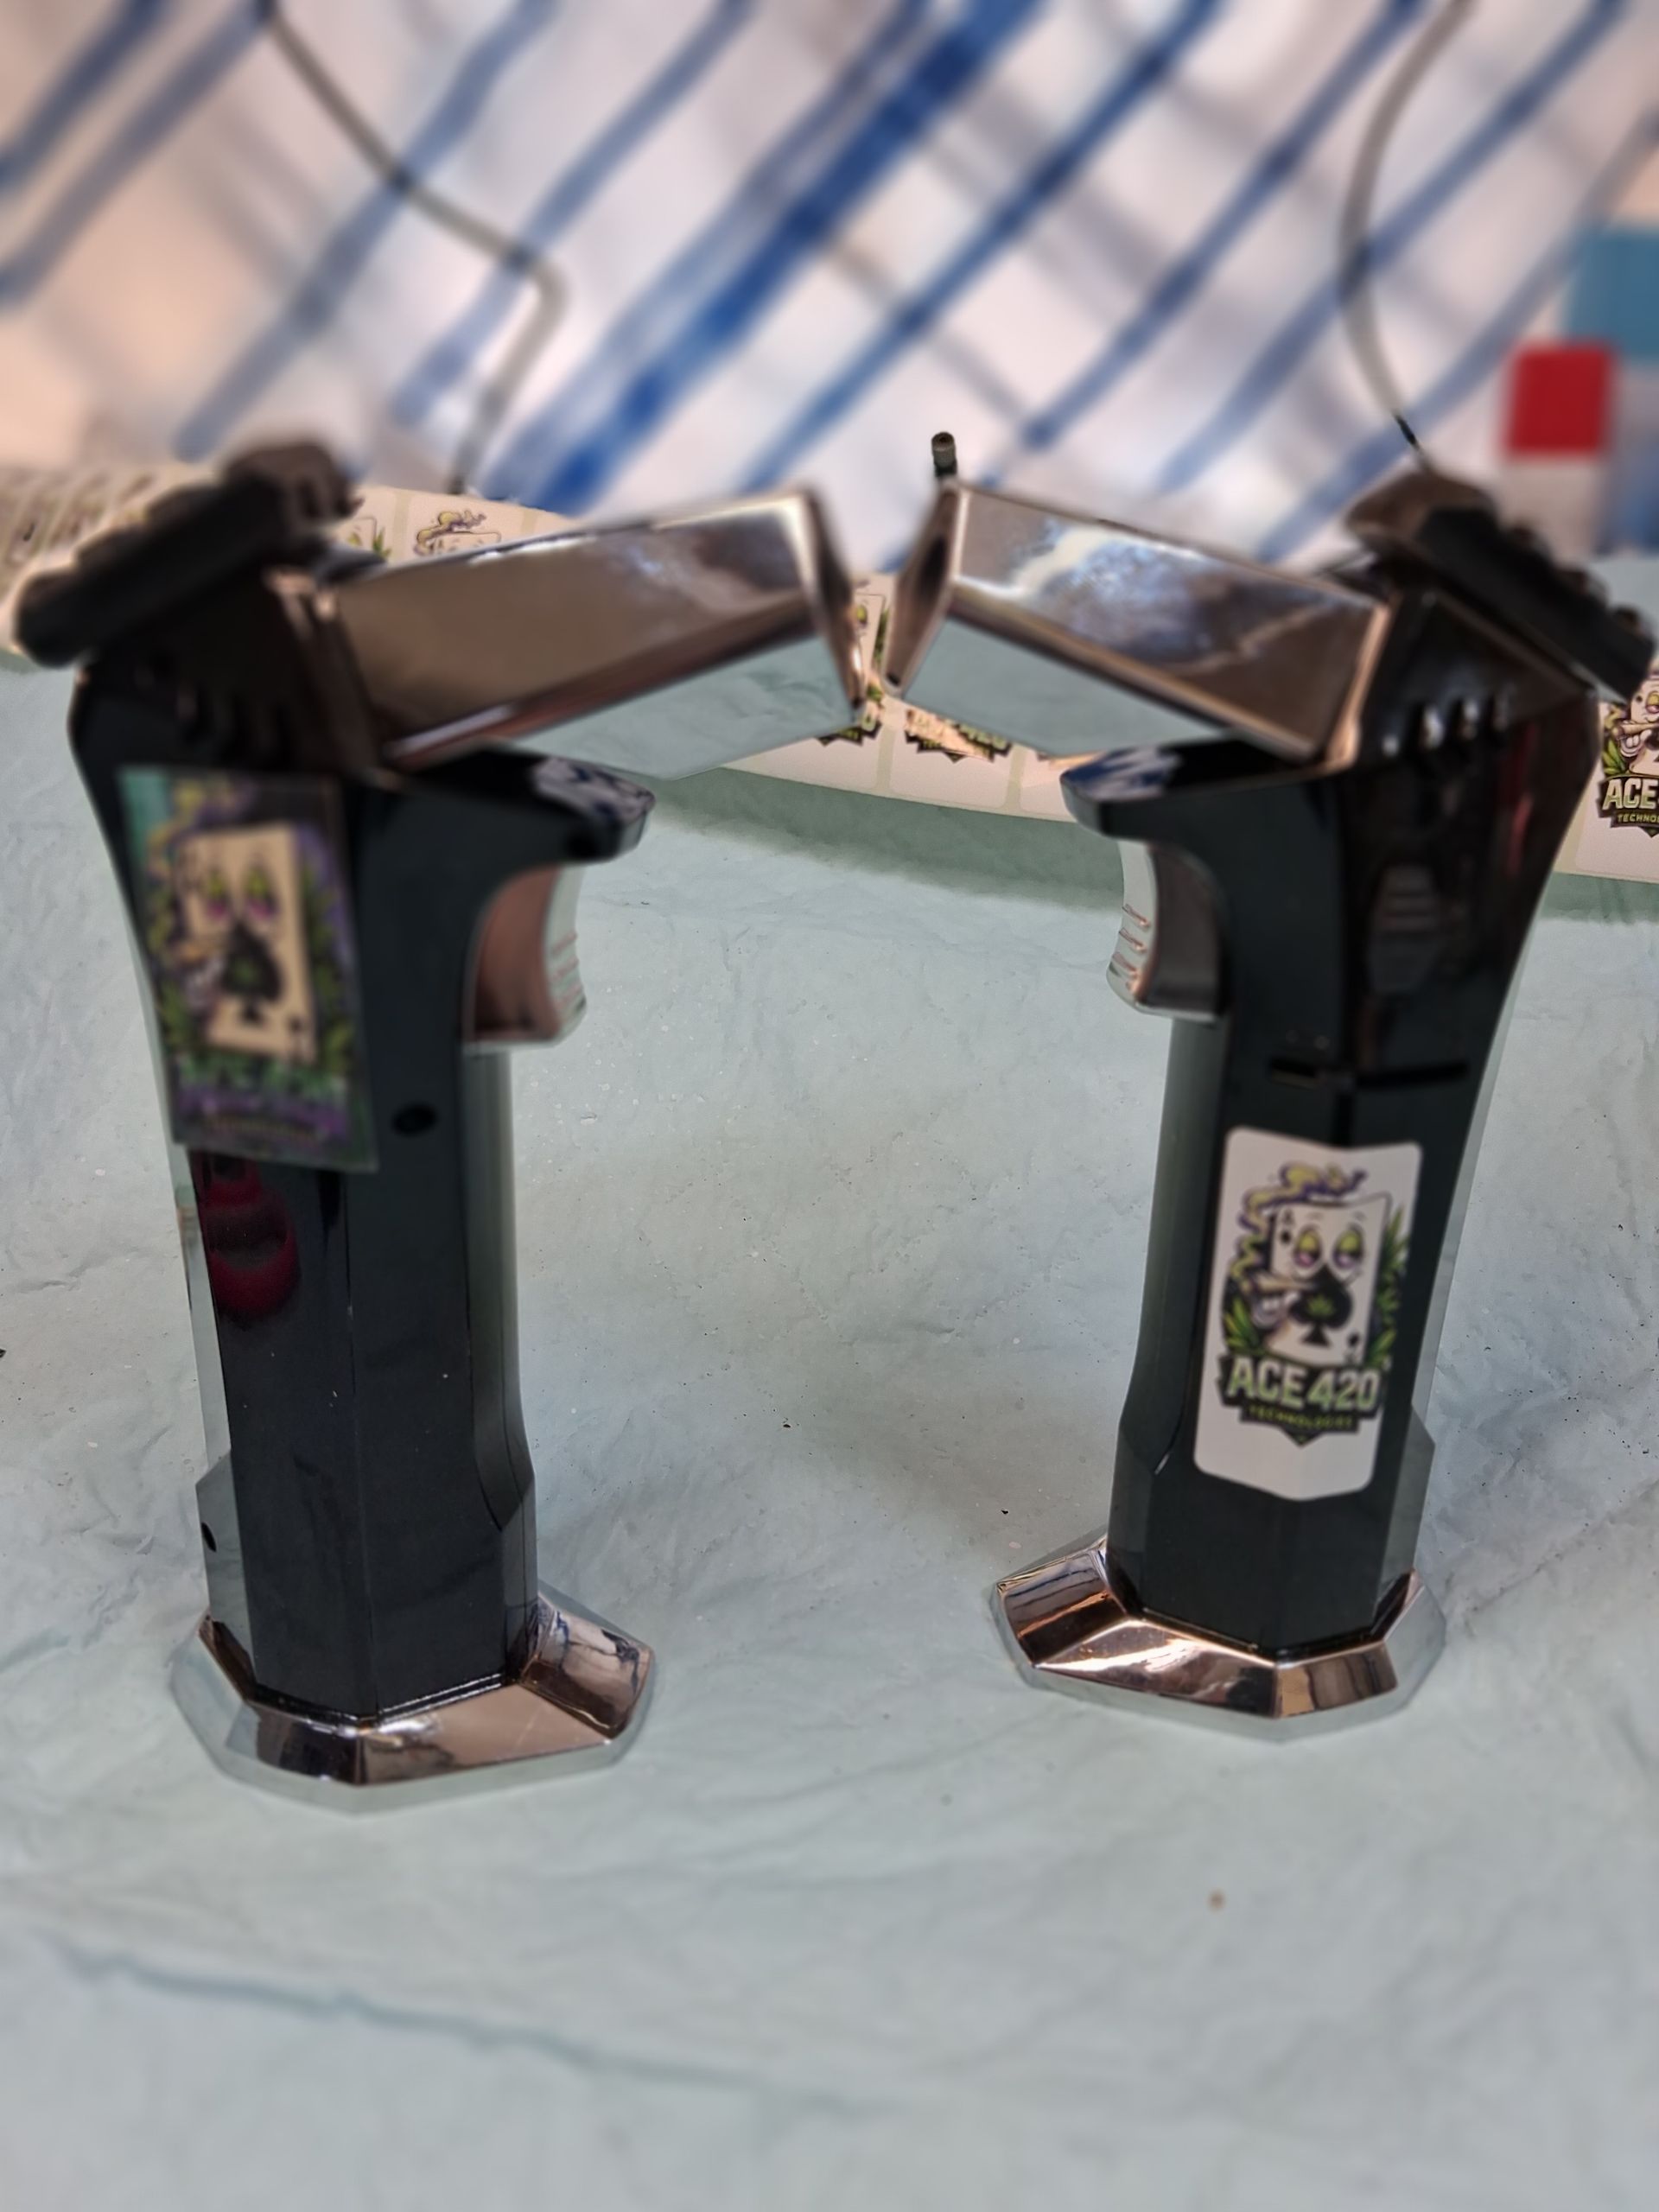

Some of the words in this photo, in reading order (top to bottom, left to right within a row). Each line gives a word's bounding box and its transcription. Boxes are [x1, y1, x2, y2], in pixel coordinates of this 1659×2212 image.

[1602, 778, 1659, 810] ACE
[1618, 813, 1659, 823] TECHNO
[1227, 1357, 1308, 1409] ACE
[1307, 1369, 1381, 1411] 420
